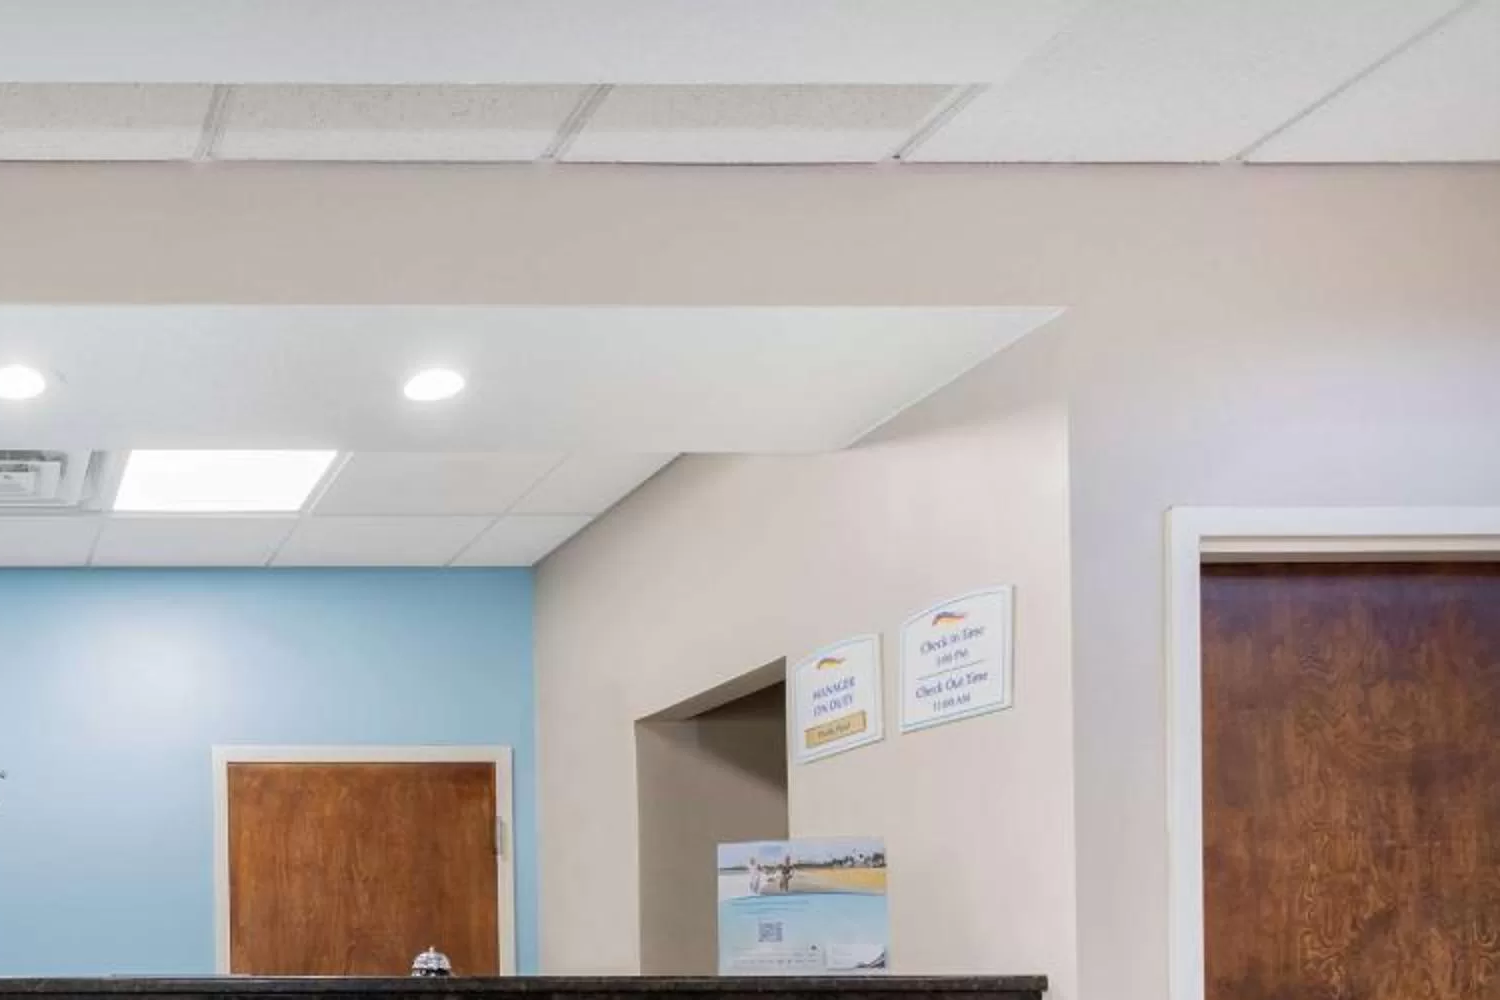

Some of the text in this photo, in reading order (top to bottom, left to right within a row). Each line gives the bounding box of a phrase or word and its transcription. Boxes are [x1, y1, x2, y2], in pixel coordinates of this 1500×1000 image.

[812, 675, 856, 700] MANAGER
[915, 680, 943, 699] Check
[966, 671, 989, 685] Time
